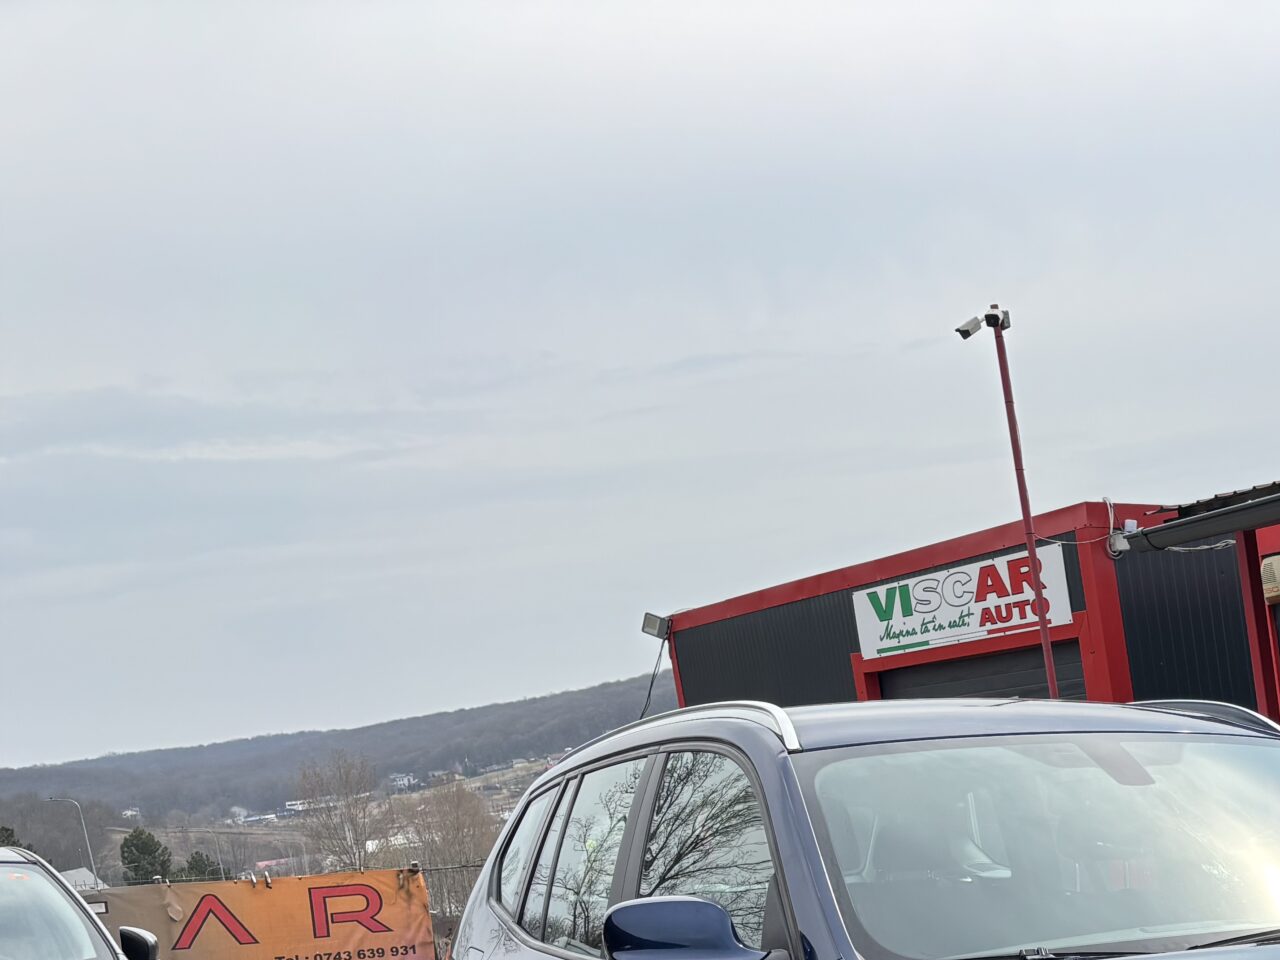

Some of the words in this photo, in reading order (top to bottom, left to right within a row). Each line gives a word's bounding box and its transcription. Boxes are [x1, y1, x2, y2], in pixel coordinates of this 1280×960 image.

[867, 557, 1047, 622] VISCAR
[357, 947, 385, 960] 639
[390, 944, 417, 956] 931
